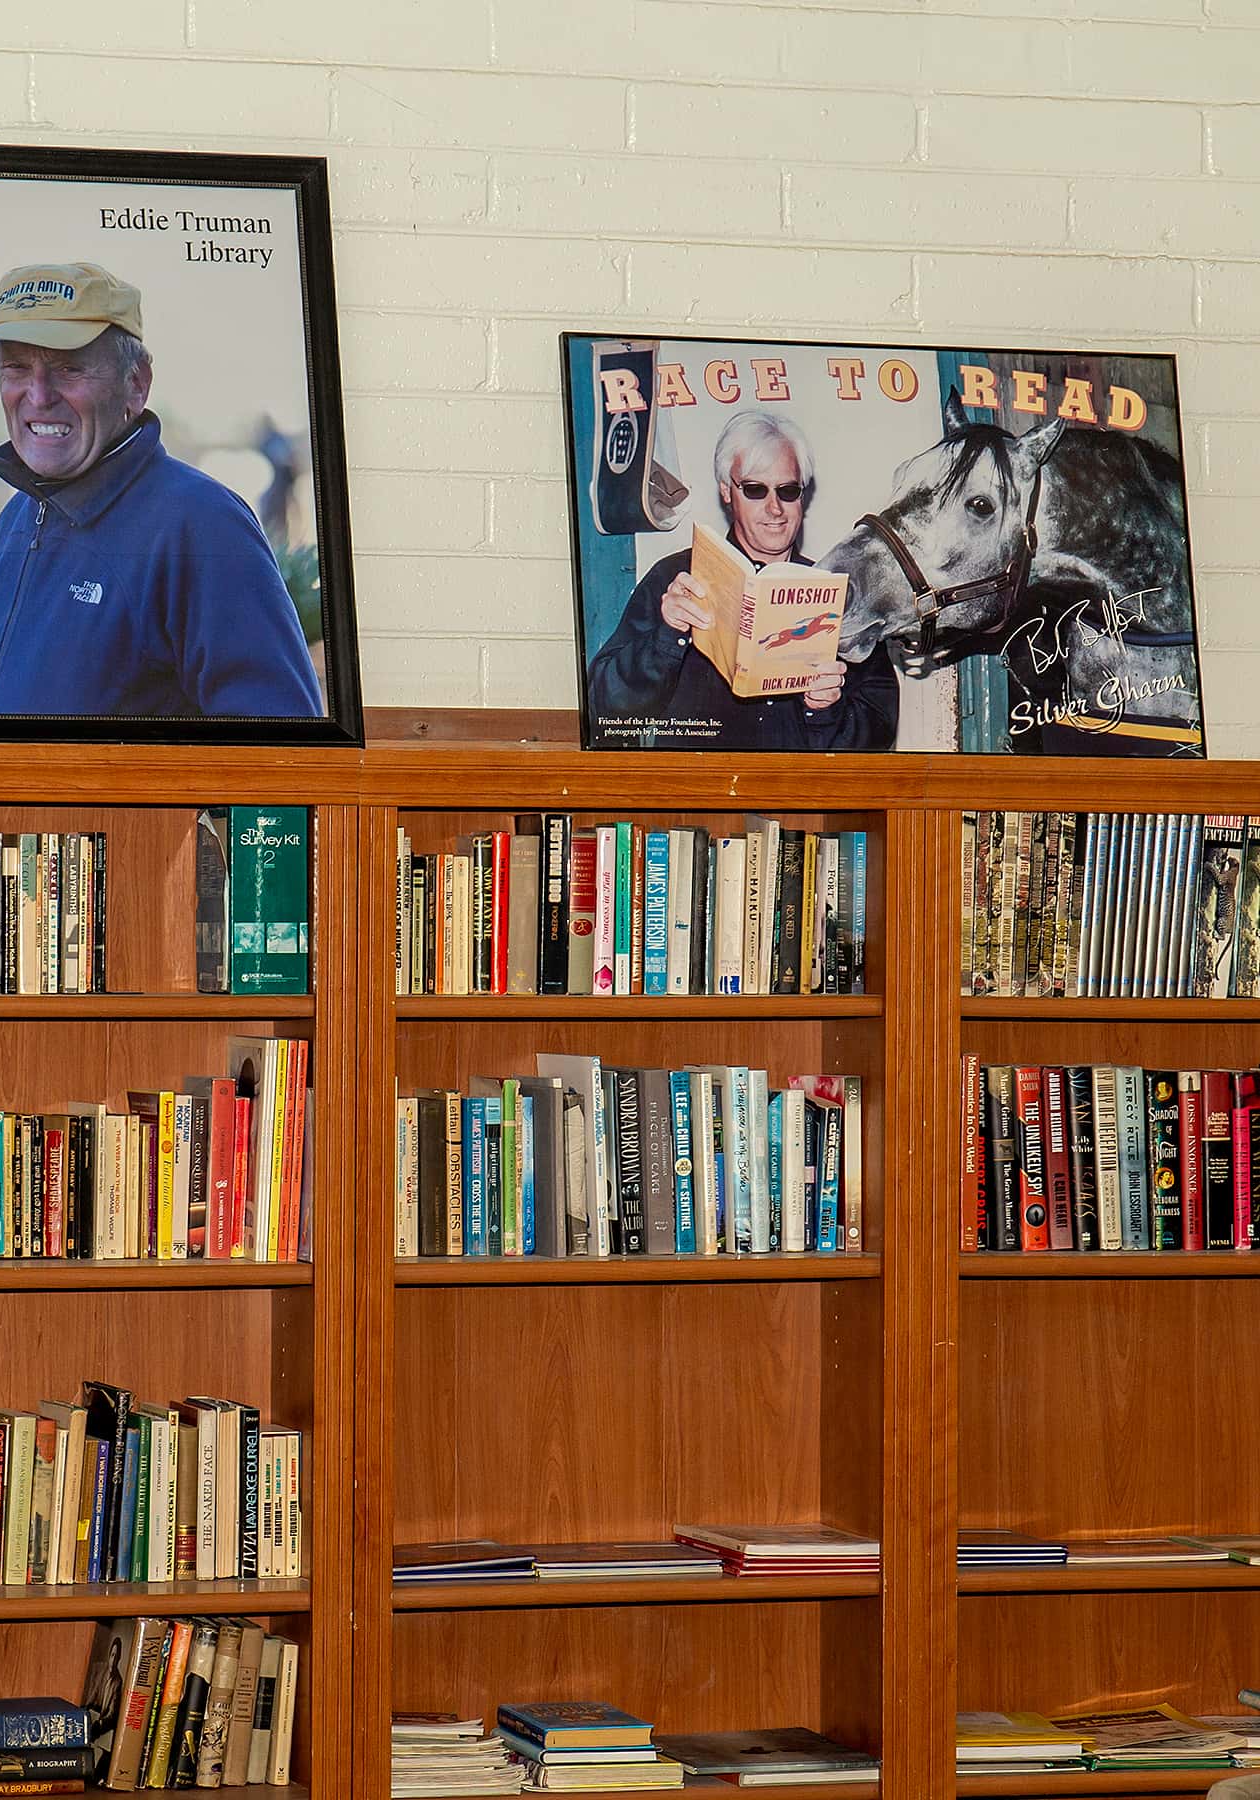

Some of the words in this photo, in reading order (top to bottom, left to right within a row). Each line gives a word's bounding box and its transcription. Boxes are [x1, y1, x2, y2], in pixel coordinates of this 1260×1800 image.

[99, 208, 169, 231] Eddie
[175, 210, 272, 234] Truman
[185, 240, 274, 268] Library
[37, 280, 74, 301] ANITA
[599, 358, 790, 417] RACE
[828, 358, 920, 403] TO
[960, 364, 1148, 432] READ
[770, 587, 840, 605] LONGSHOT
[739, 593, 757, 641] LONGSHOT
[762, 677, 783, 691] DICK
[1008, 698, 1090, 736] Silver
[1096, 675, 1187, 711] Charm
[597, 716, 622, 726] Friends
[623, 716, 632, 726] of
[632, 716, 643, 726] the
[644, 717, 669, 728] Library
[709, 718, 723, 727] Inc.
[604, 727, 641, 737] photograph
[642, 727, 651, 737] by
[652, 727, 675, 736] Benoit
[675, 728, 683, 736] &
[240, 834, 284, 848] Survey
[284, 834, 300, 846] Kit
[246, 828, 265, 838] The
[69, 838, 77, 859] Borges
[263, 849, 276, 866] 2
[548, 819, 563, 877] FICTION
[962, 841, 973, 870] RUSSIA
[69, 864, 77, 915] LABYRINTHS
[548, 878, 563, 903] 100
[646, 860, 665, 895] JAMES
[827, 869, 837, 898] FORT
[962, 871, 973, 908] BESIEGED
[748, 877, 759, 921] HAIKU
[646, 896, 665, 951] PATTERSON
[966, 1055, 978, 1114] Mathematics
[999, 1073, 1010, 1105] Martha
[1048, 1072, 1062, 1111] JONATHAN
[1068, 1069, 1092, 1125] SUSAN
[1096, 1083, 1116, 1105] WAY
[1124, 1076, 1135, 1121] MERCY
[619, 1077, 640, 1130] SANDRA
[675, 1091, 687, 1108] LEE
[1024, 1100, 1039, 1122] THE
[1096, 1106, 1116, 1119] OF
[1148, 1103, 1180, 1122] SHADOW
[1187, 1097, 1196, 1124] LOSS
[175, 1105, 184, 1130] PEOPLE
[182, 1105, 191, 1143] MOUNTAIN
[449, 1098, 460, 1135] Lettau
[471, 1116, 482, 1138] JAMES
[966, 1115, 977, 1125] In
[1000, 1106, 1012, 1138] Grimes
[676, 1128, 688, 1156] CHILD
[827, 1121, 837, 1147] CLIVE
[966, 1126, 977, 1145] Our
[1050, 1112, 1064, 1153] KELLERMAN
[1097, 1121, 1118, 1172] DECEPTION
[1126, 1127, 1136, 1161] RULE
[471, 1139, 483, 1175] PATTERSON
[620, 1131, 642, 1183] BROWN
[965, 1146, 976, 1174] World
[1025, 1124, 1042, 1175] UNLIKELY
[1154, 1140, 1178, 1161] NIGHT
[48, 1146, 61, 1208] SHAKESPEARE
[191, 1142, 204, 1203] CONQUISTA
[1003, 1162, 1013, 1178] The
[1187, 1135, 1197, 1194] INNOCENCE
[450, 1153, 461, 1230] OBSTACLES
[471, 1179, 483, 1203] CROSS
[680, 1178, 689, 1190] THE
[1003, 1178, 1014, 1201] Grave
[1027, 1176, 1043, 1198] SPY
[1071, 1165, 1098, 1220] ISAACS
[1128, 1169, 1140, 1190] JOHN
[471, 1203, 483, 1218] THE
[624, 1200, 640, 1215] THE
[680, 1190, 691, 1232] SENTINEL
[1004, 1201, 1014, 1231] Maurice
[1129, 1190, 1142, 1234] LESCROART
[471, 1219, 483, 1235] LINE
[820, 1206, 832, 1239] THIEF
[203, 1444, 213, 1477] FACE
[245, 1427, 258, 1473] DURRELL
[202, 1479, 213, 1522] NAKED
[244, 1476, 258, 1529] LAWRENCE
[202, 1524, 213, 1550] THE
[242, 1530, 257, 1571] LIVIA
[37, 1759, 77, 1768] BIOGRAPHY
[10, 1783, 53, 1794] BRADBURY
